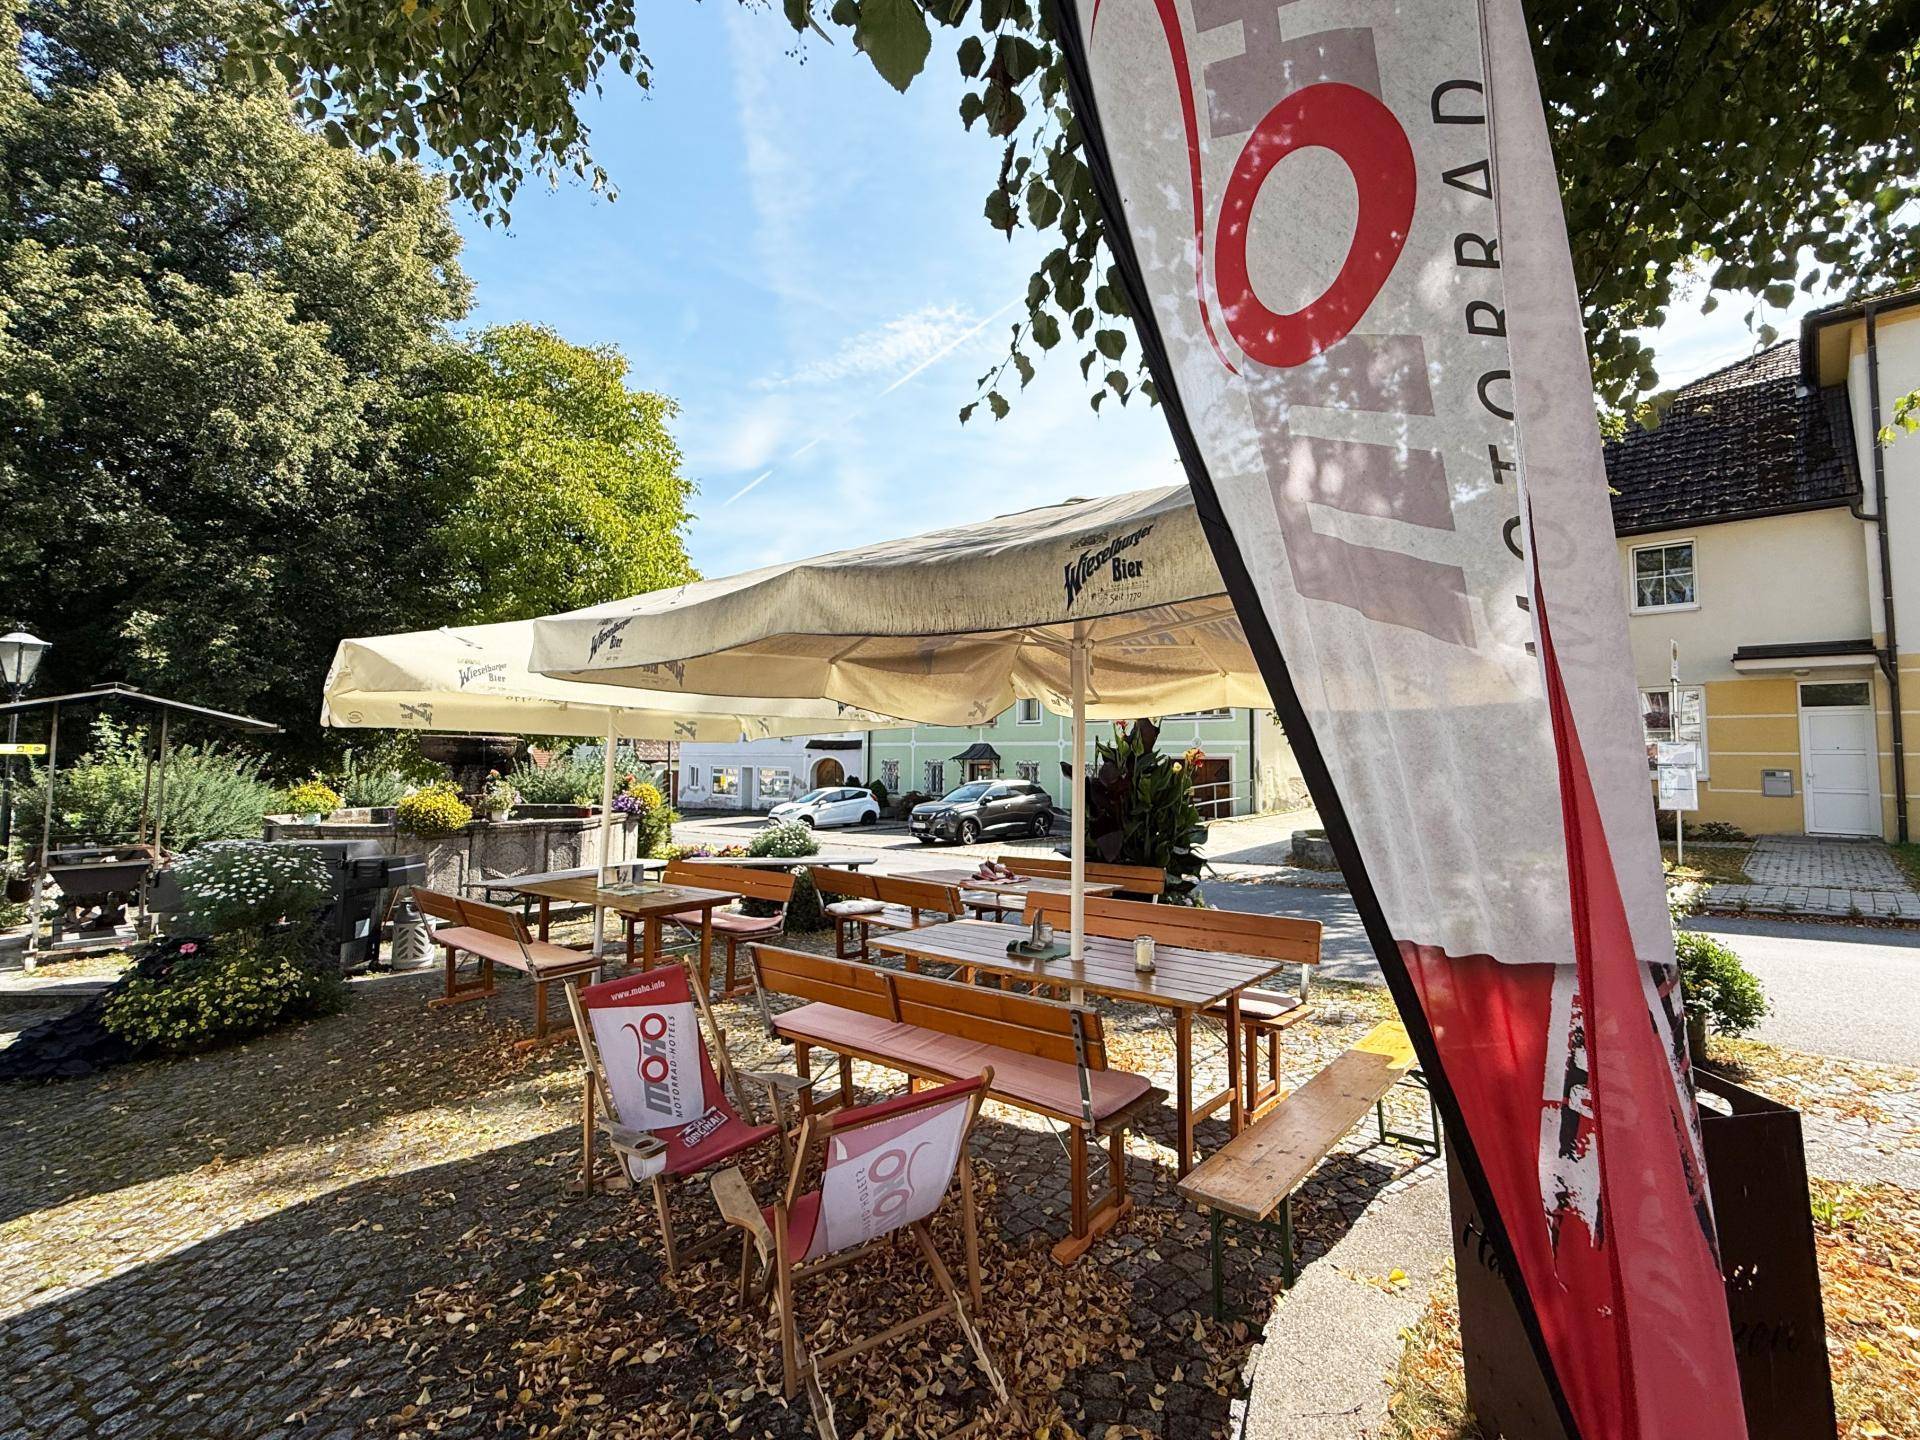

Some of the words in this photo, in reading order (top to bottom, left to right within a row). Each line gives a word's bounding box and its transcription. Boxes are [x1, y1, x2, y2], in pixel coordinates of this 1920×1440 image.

[1064, 524, 1154, 611] Wieselburger
[1112, 558, 1143, 582] Bier
[611, 980, 666, 1001] www.moho.info
[668, 1015, 684, 1118] MOTORRAD-HOTELS
